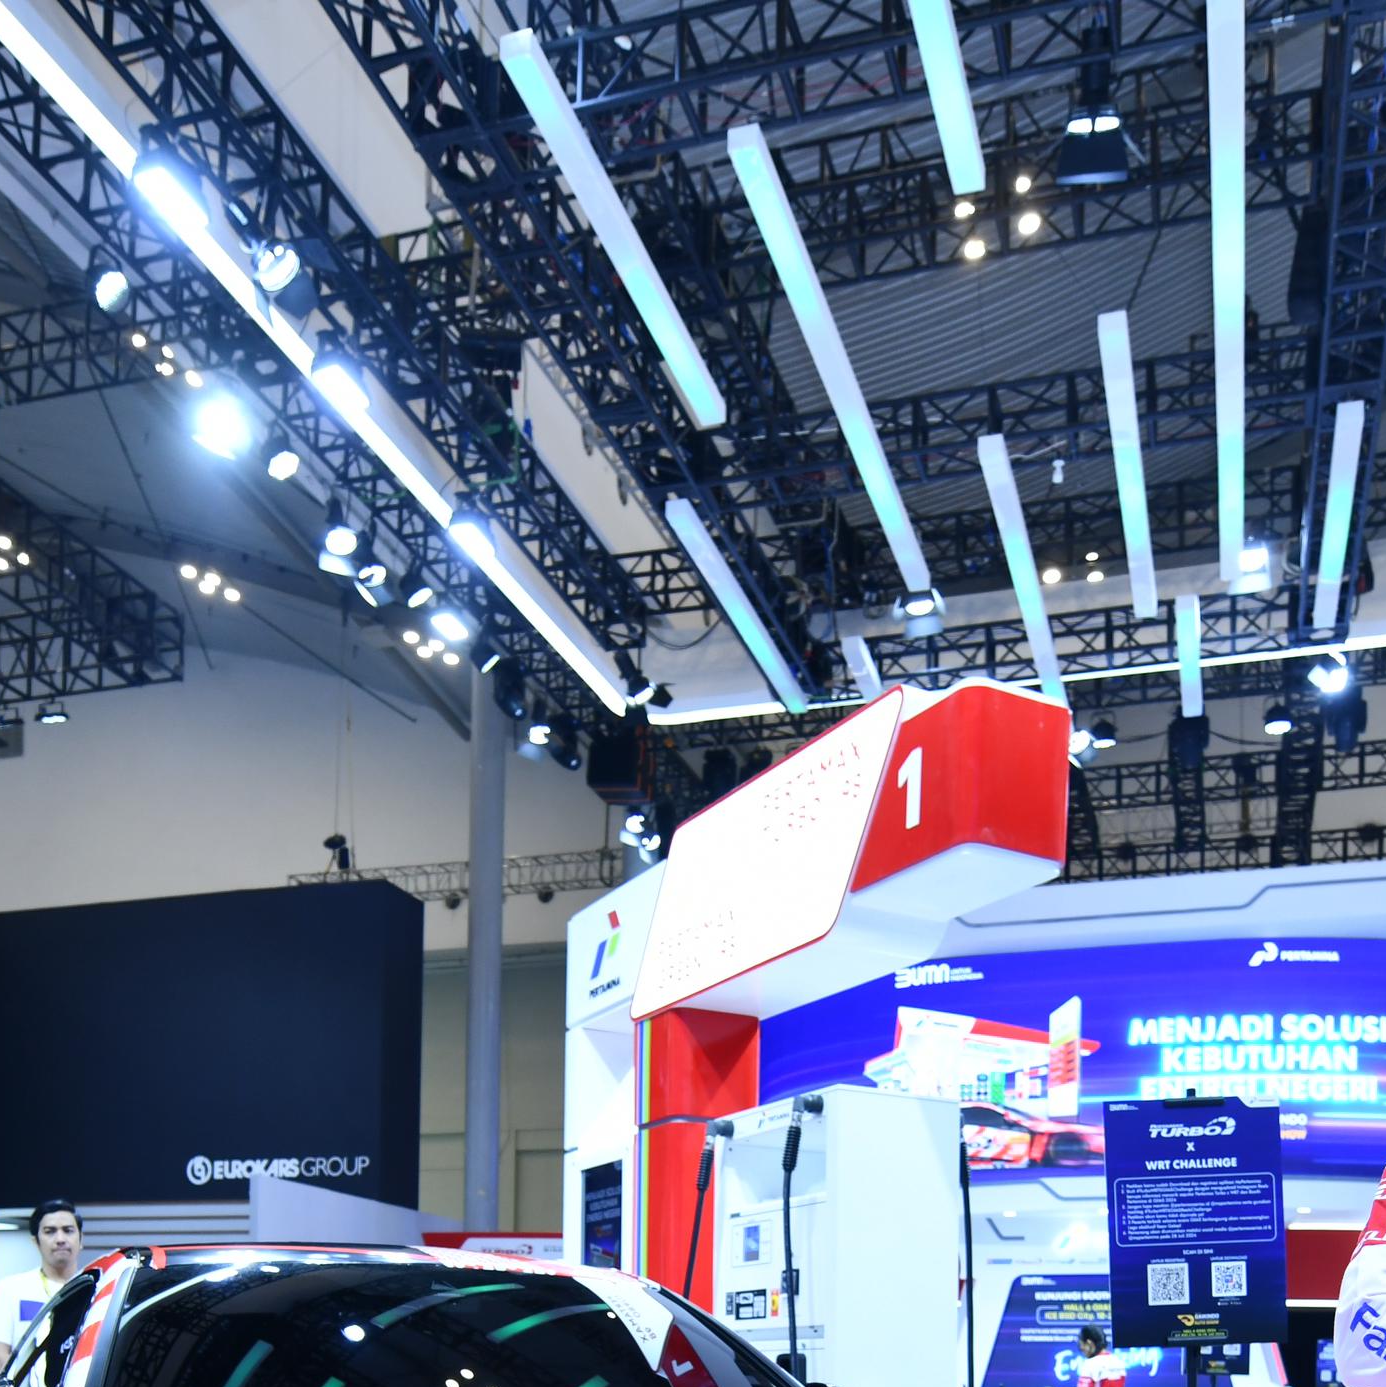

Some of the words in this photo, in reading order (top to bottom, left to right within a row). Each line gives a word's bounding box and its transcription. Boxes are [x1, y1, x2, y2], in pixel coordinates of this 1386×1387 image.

[898, 746, 923, 830] 1
[1128, 1015, 1274, 1047] MENJADI
[1161, 1046, 1358, 1073] KEBUTUHAN
[1140, 1075, 1258, 1100] ENERGI
[1264, 1075, 1379, 1102] NEGERI
[1148, 1125, 1219, 1139] TURBO
[300, 1156, 370, 1177] GROUP
[1145, 1159, 1171, 1171] WRT
[1173, 1156, 1238, 1169] CHALLENGE
